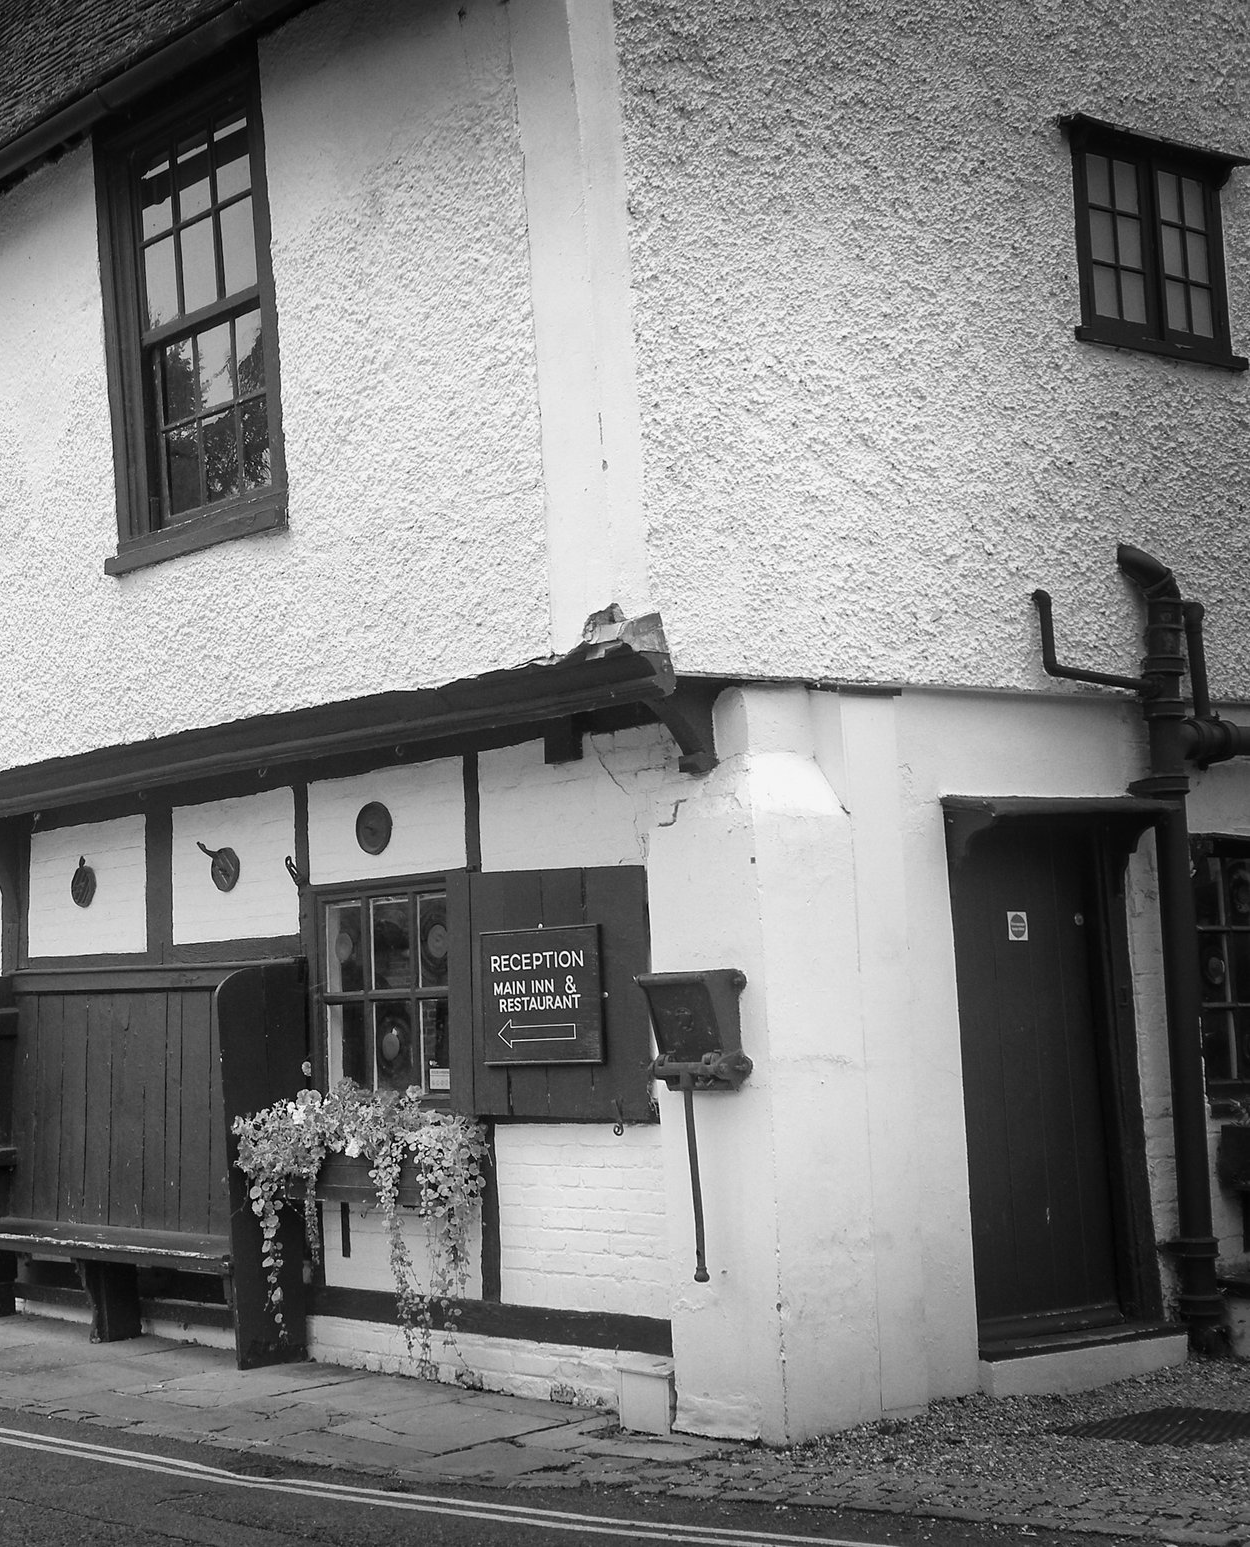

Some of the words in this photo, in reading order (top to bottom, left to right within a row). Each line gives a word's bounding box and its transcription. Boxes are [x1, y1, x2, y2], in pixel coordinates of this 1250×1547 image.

[490, 950, 585, 973] RECEPTION
[493, 980, 526, 996] MAIN
[531, 978, 555, 994] INN
[564, 975, 577, 994] &
[499, 994, 581, 1013] RESTAURANT
